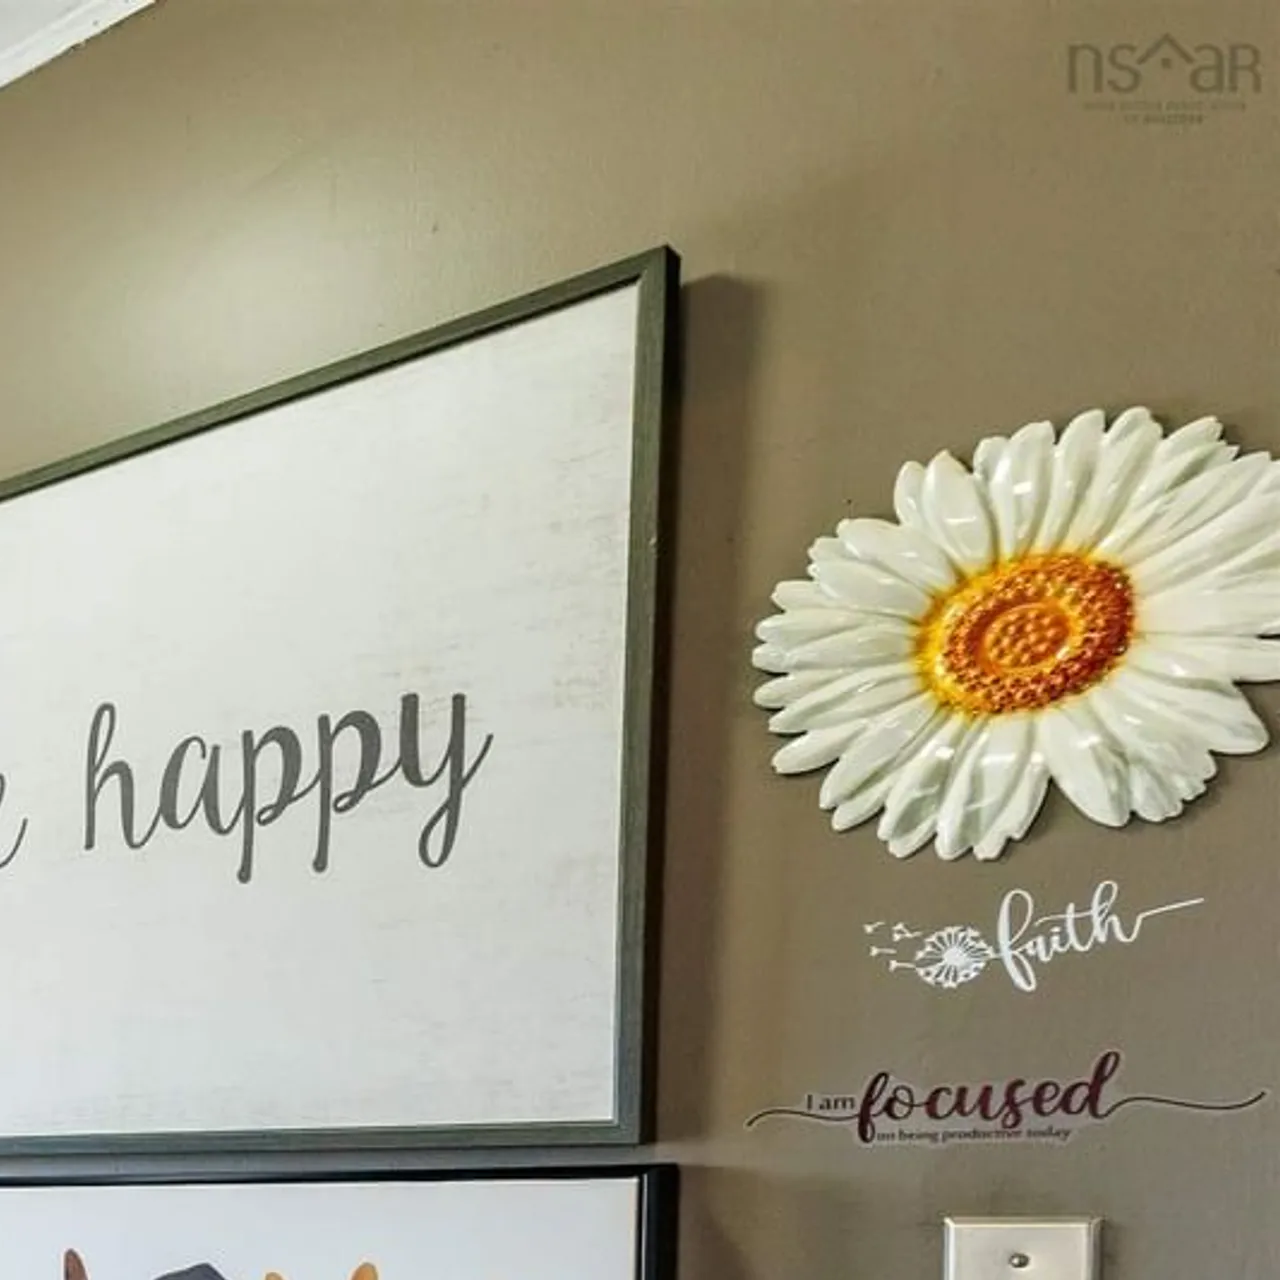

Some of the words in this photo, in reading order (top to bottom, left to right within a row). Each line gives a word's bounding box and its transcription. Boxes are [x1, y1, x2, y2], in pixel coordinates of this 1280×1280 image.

[84, 692, 494, 885] happy
[996, 881, 1204, 992] faith
[806, 1094, 813, 1111] I
[818, 1094, 855, 1111] am
[857, 1050, 1122, 1144] focused
[1026, 1126, 1071, 1142] today
